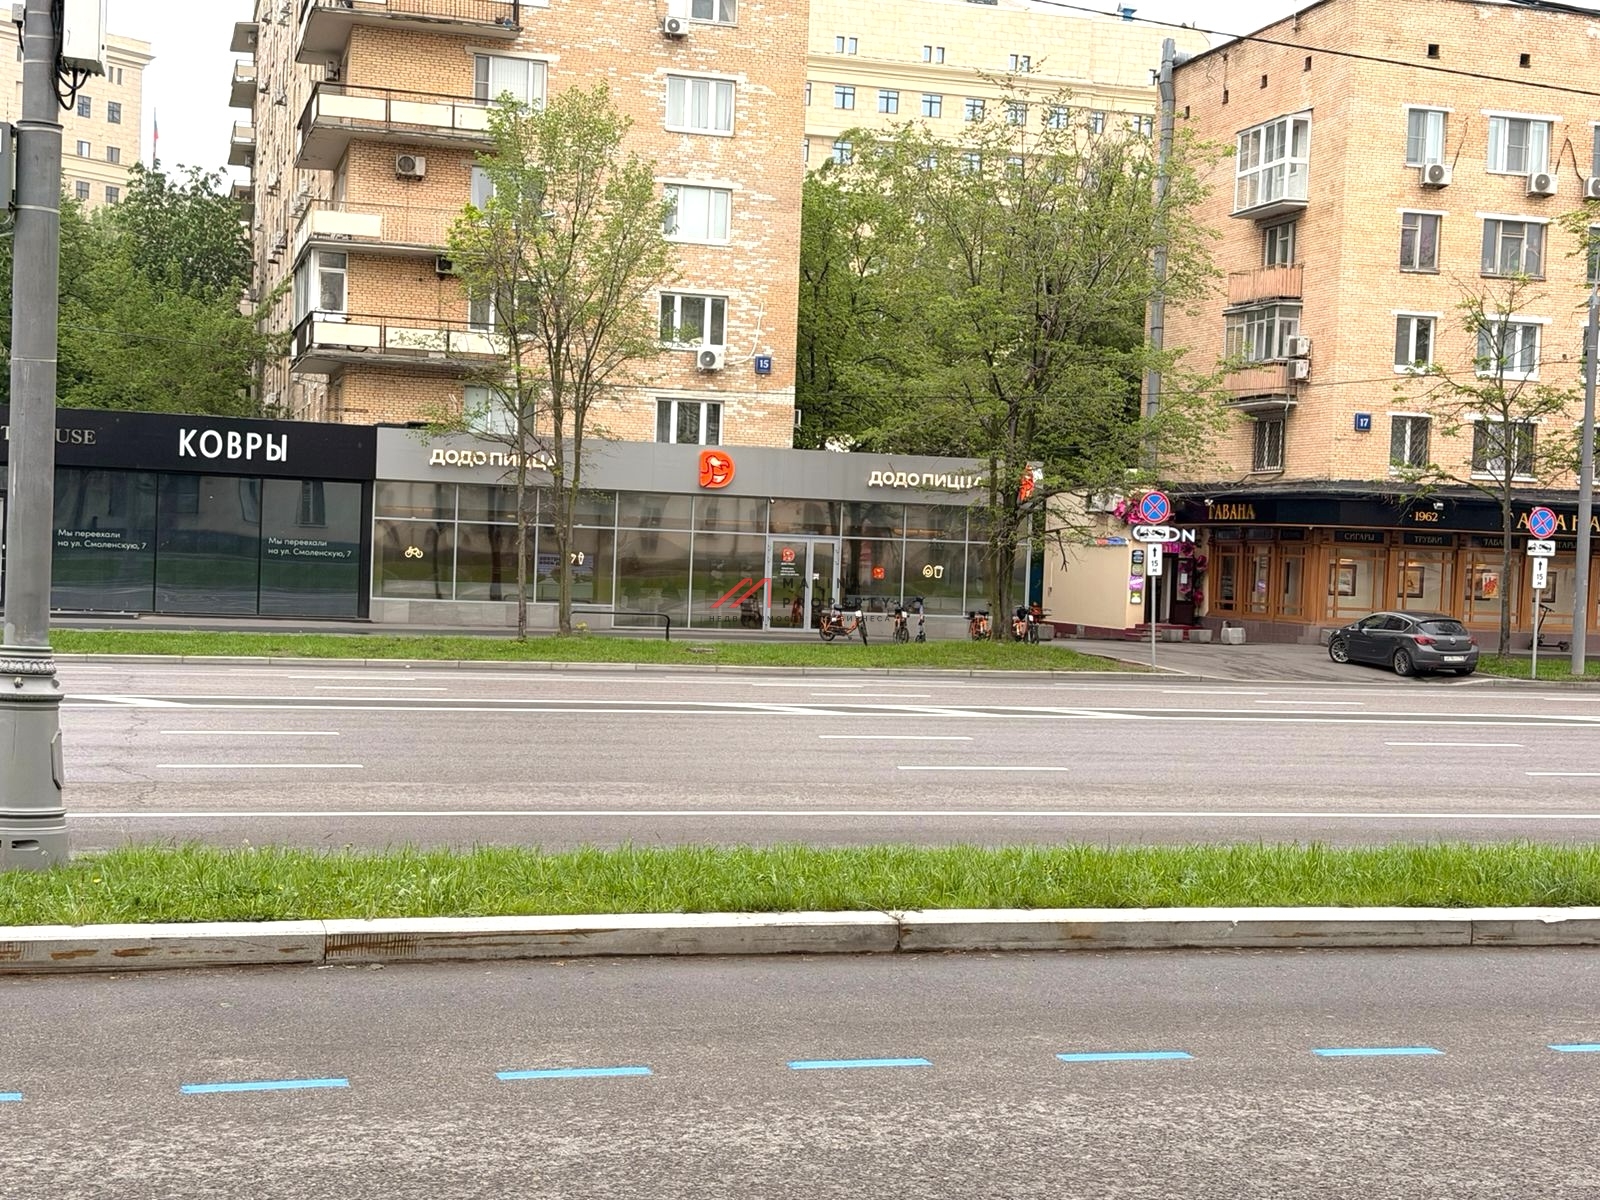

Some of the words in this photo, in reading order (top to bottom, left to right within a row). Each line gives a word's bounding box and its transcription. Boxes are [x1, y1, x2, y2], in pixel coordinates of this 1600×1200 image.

[759, 359, 770, 369] 15
[1359, 418, 1369, 427] 17
[178, 427, 288, 462] КОВРЫ
[429, 448, 487, 467] ДОДО
[868, 470, 920, 489] ДОДО
[1208, 503, 1256, 520] ГАВАНА
[1414, 511, 1439, 522] 1962
[58, 529, 73, 537] Мы
[74, 530, 121, 539] переехали
[1344, 532, 1375, 542] СИГАРЫ
[84, 540, 140, 550] Смоленскую,
[268, 537, 283, 545] Мы
[284, 538, 327, 547] переехали
[292, 548, 345, 558] Смоленскую,
